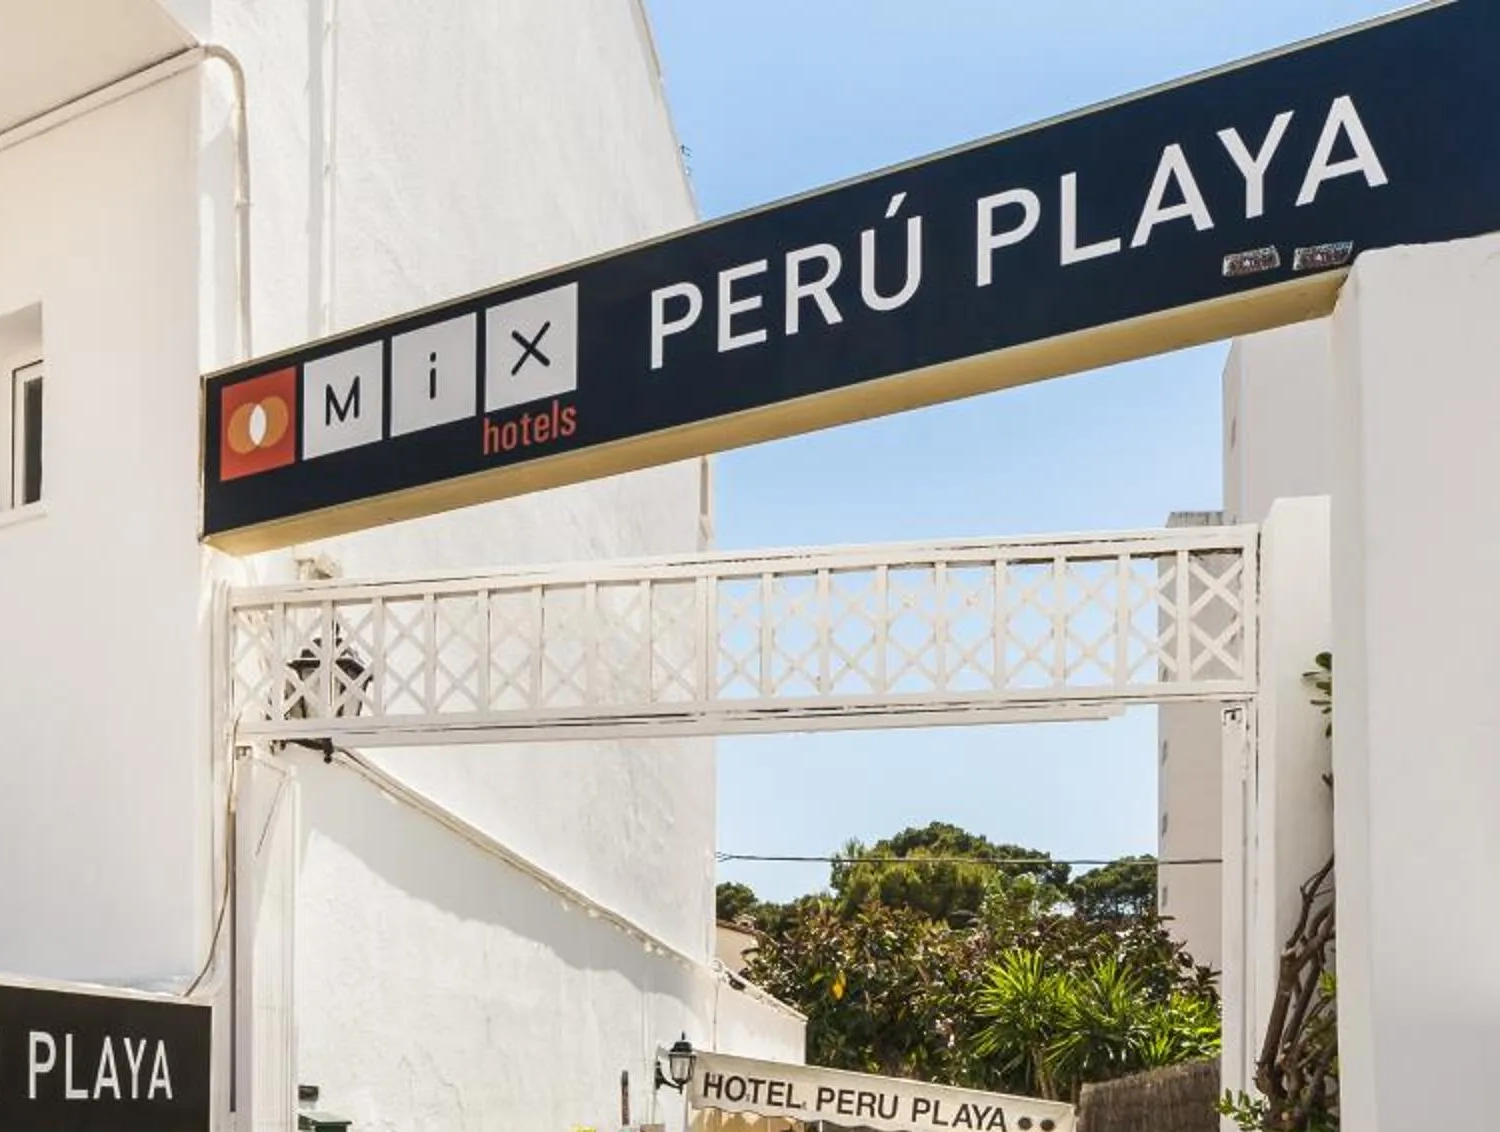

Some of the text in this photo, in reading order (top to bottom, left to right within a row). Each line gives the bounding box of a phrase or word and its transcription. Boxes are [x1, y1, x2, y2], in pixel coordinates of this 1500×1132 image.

[651, 95, 1389, 370] PERÚ PLAYA
[483, 400, 577, 457] hotels
[29, 1031, 174, 1100] PLAYA
[703, 1071, 802, 1109] HOTEL
[815, 1086, 899, 1120] PERU
